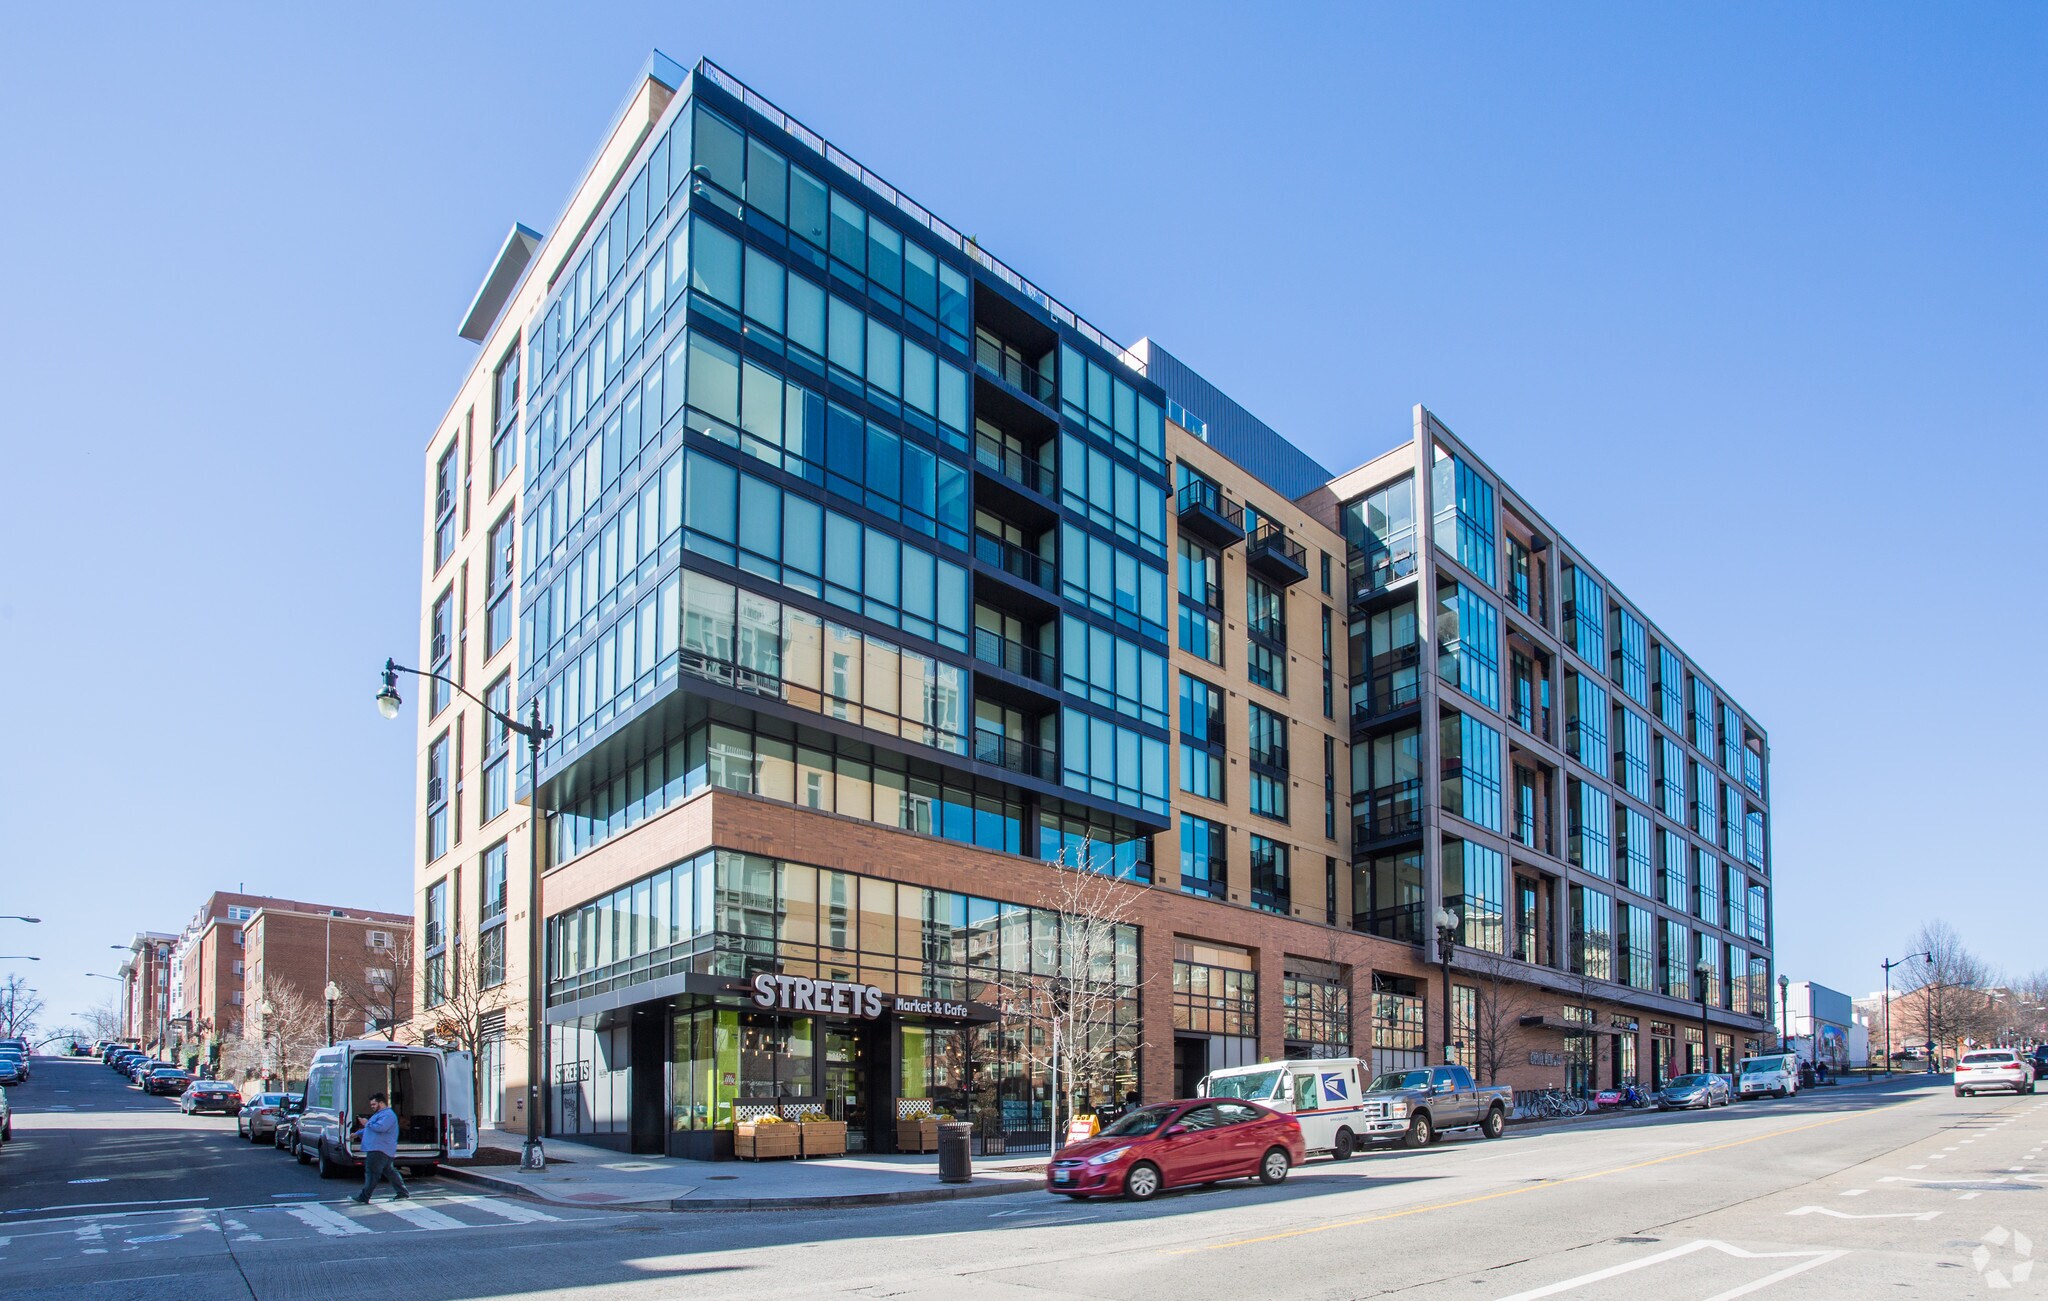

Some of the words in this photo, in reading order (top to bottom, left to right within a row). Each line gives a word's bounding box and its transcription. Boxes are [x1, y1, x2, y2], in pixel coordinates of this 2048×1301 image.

[754, 973, 882, 1017] STREETS
[895, 998, 932, 1014] Market
[934, 1001, 942, 1014] &
[943, 1002, 968, 1016] Cafe
[555, 1061, 589, 1084] STREETS
